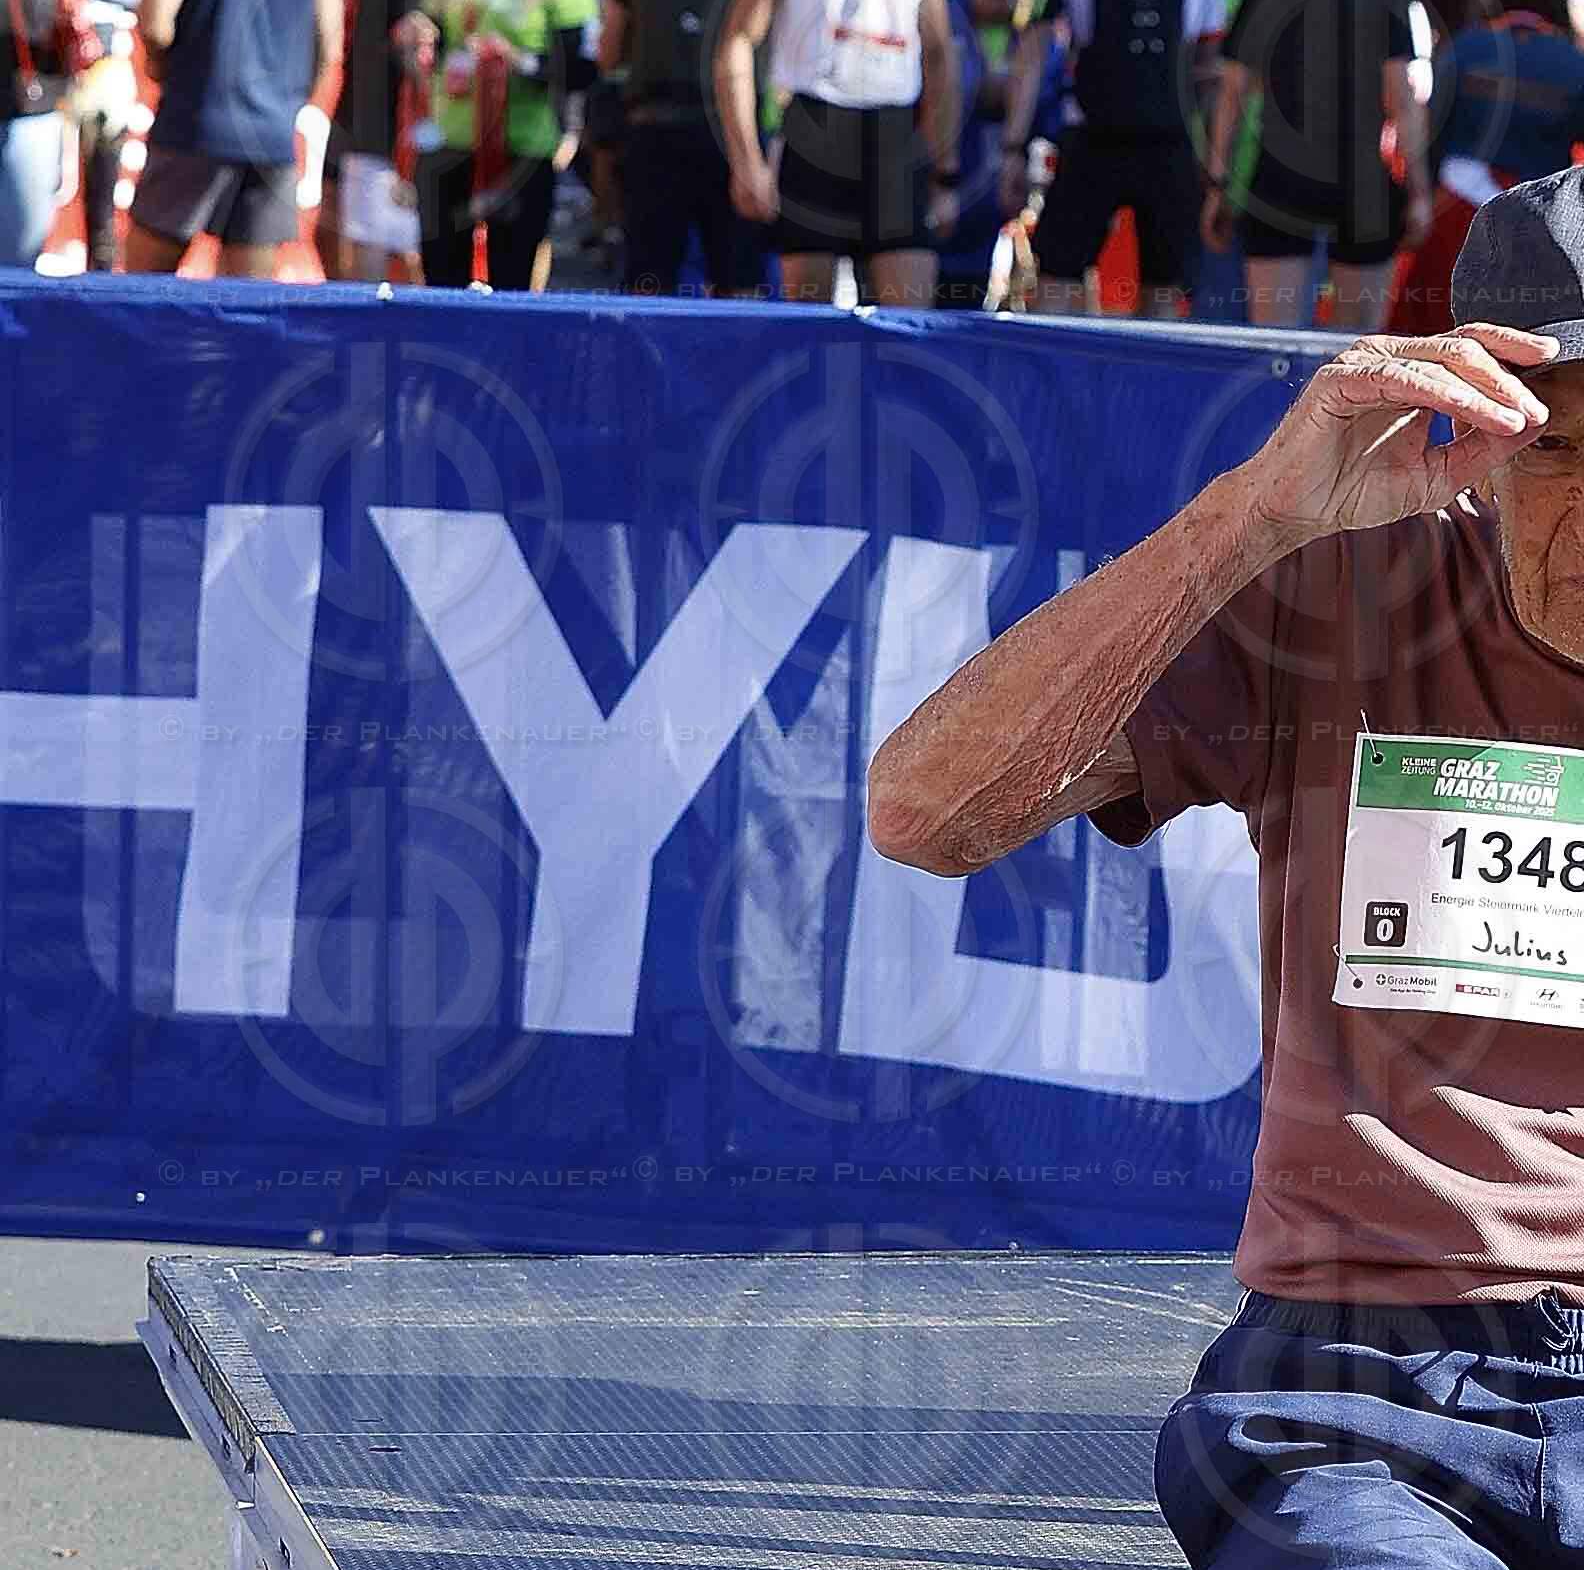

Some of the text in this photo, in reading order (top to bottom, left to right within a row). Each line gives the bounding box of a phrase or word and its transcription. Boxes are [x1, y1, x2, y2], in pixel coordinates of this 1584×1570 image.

[1400, 765, 1436, 775] ZEITUNG
[1401, 757, 1437, 767] KLEINE
[1440, 758, 1501, 780] GRAZ
[1433, 777, 1560, 807] MARATHON
[1431, 892, 1475, 908] Energie
[1373, 906, 1401, 917] BLOCK
[1376, 918, 1394, 942] 0
[1471, 920, 1568, 966] Julius
